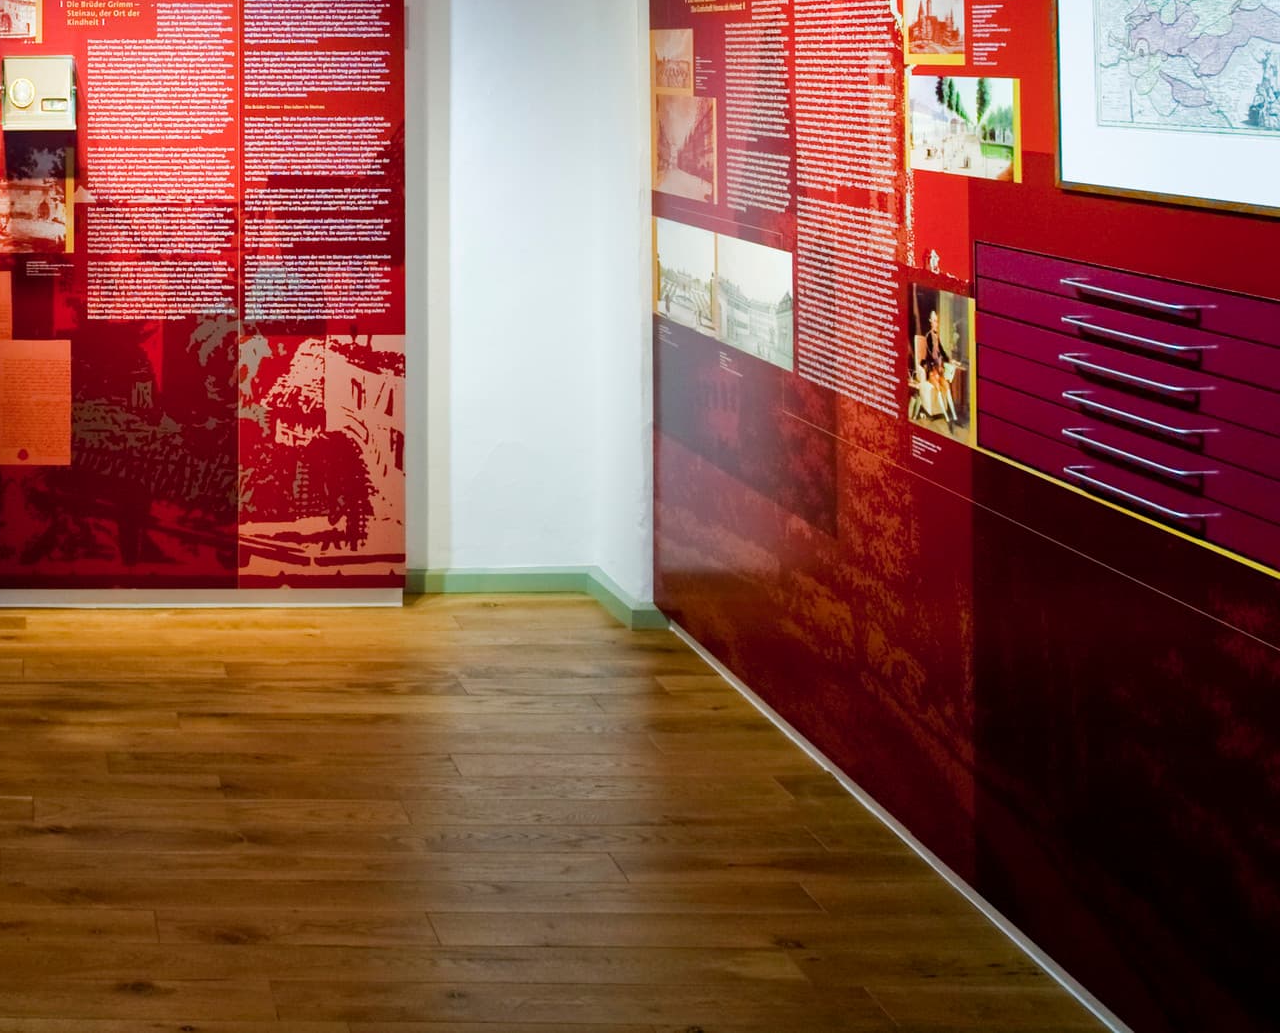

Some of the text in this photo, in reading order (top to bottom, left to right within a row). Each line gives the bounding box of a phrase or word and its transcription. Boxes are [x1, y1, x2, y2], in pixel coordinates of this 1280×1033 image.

[66, 0, 78, 8] Die
[81, 0, 106, 8] Brüder
[108, 0, 133, 8] Grimm
[67, 9, 140, 18] Steinau, der Ort der
[67, 18, 99, 27] Kindheit
